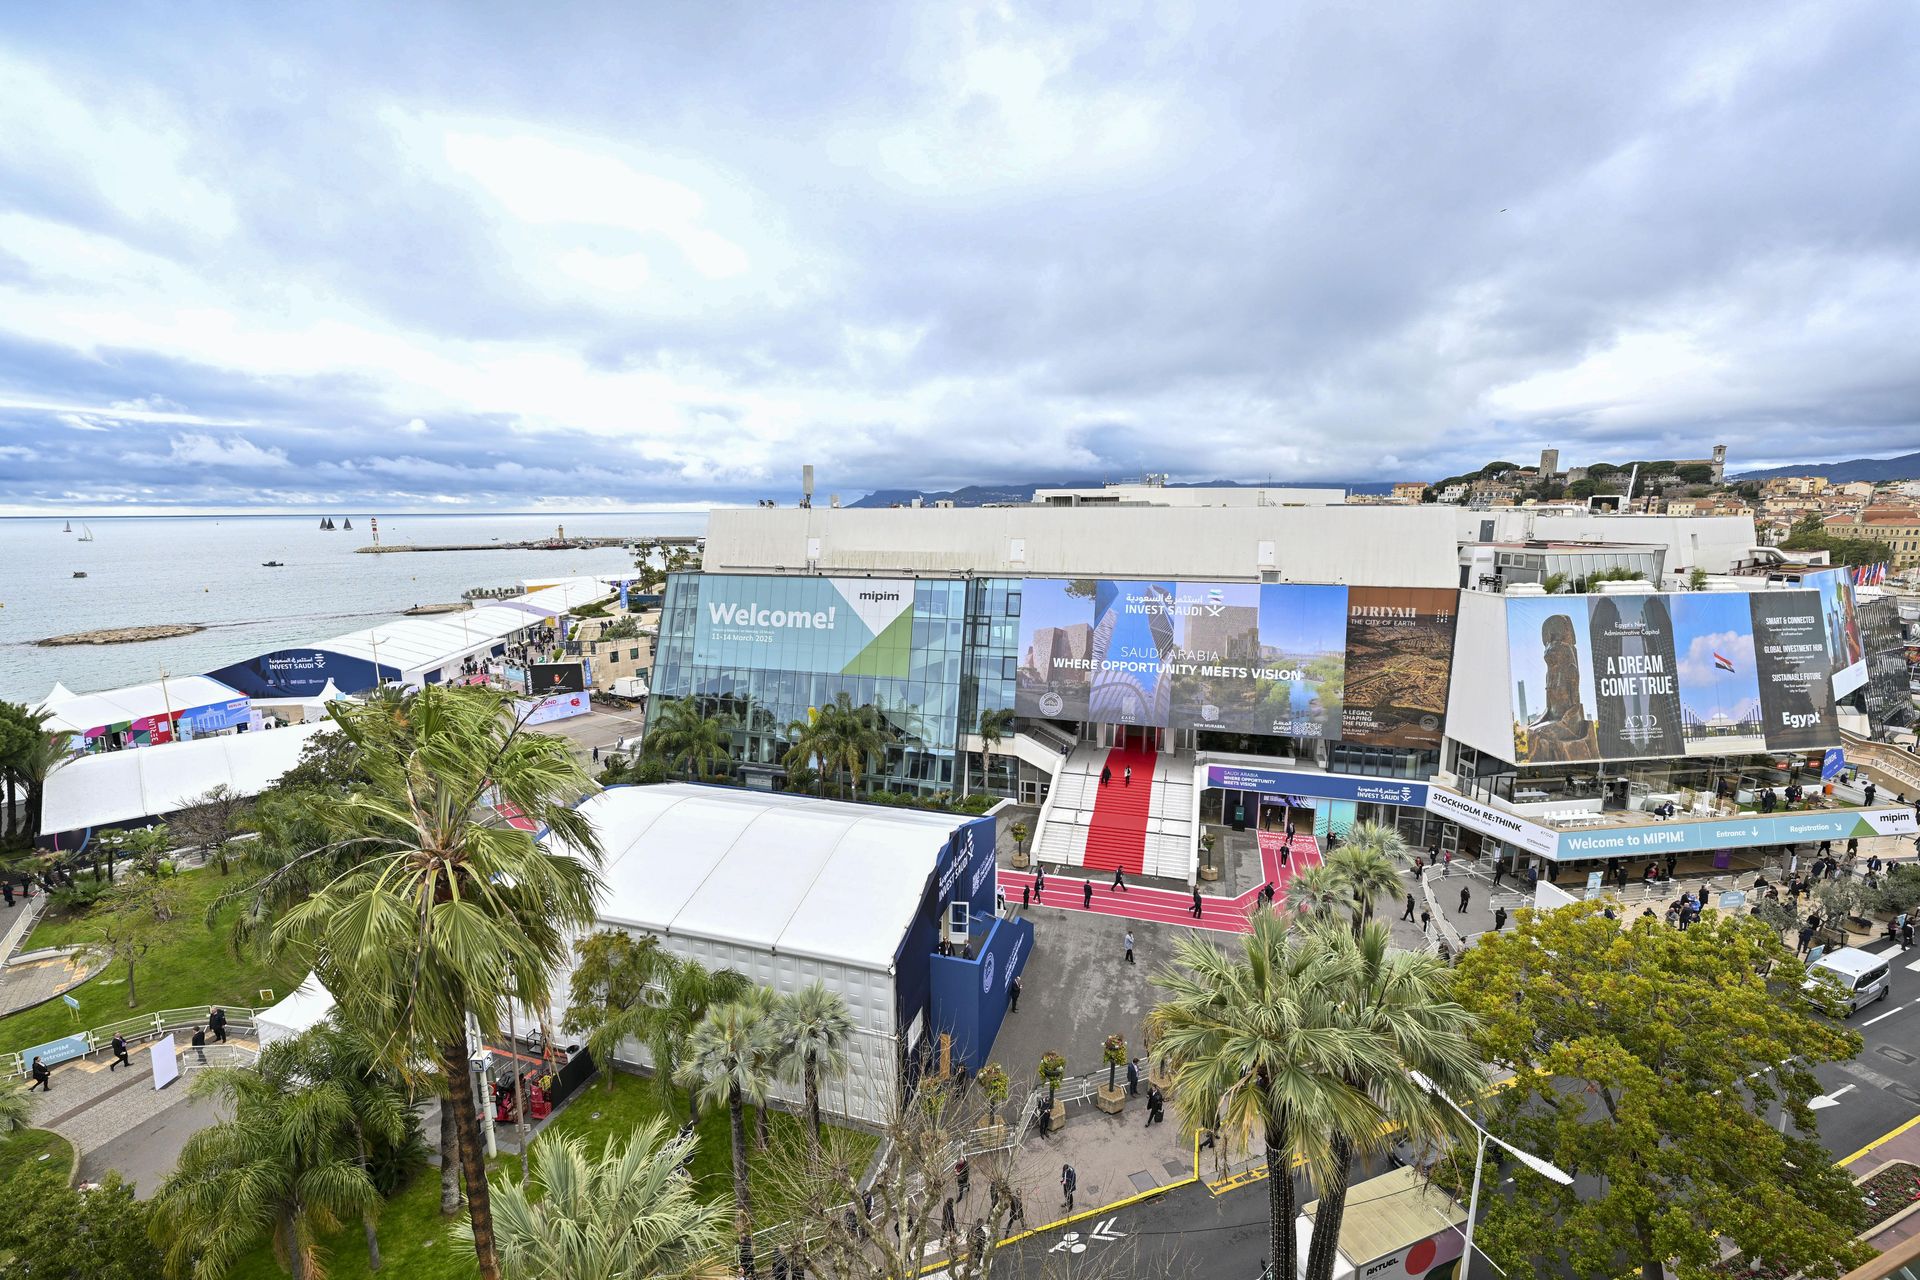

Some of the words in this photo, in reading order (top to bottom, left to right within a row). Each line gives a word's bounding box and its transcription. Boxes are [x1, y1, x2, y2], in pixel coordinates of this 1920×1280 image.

[860, 591, 899, 602] mipim
[709, 602, 836, 629] Welcome!
[1125, 605, 1165, 615] INVEST
[1168, 606, 1202, 616] SAUDI
[1352, 606, 1416, 618] DIRIYAH
[1766, 617, 1782, 625] SMART
[1787, 616, 1815, 624] CONNECTED
[733, 634, 753, 642] March
[1121, 647, 1162, 659] SAUDI
[1168, 650, 1220, 661] ARABIA
[1764, 645, 1782, 653] GLOBAL
[1783, 644, 1812, 652] INVESTMENT
[1813, 644, 1823, 652] HUB
[1053, 658, 1097, 670] WHERE
[1101, 660, 1197, 675] OPPORTUNITY
[1201, 666, 1247, 679] MEETS
[1251, 668, 1301, 680] VISION
[1607, 656, 1616, 674] A
[1618, 655, 1663, 674] DREAM
[1772, 673, 1803, 681] SUSTAINABLE
[1804, 672, 1822, 680] FUTURE
[1601, 677, 1638, 696] COME
[1640, 676, 1673, 695] TRUE
[1782, 711, 1821, 728] Egypt
[1433, 793, 1480, 816] STOCKHOLM
[1482, 811, 1522, 832] RE:THINK
[1880, 812, 1910, 823] mipim
[1716, 829, 1746, 838] Entrance
[1790, 823, 1830, 834] Registration
[1568, 837, 1624, 850] Welcome
[1627, 834, 1640, 846] to
[1643, 831, 1685, 845] MIPIM!
[939, 873, 954, 902] INVEST
[955, 855, 968, 879] SAUDI
[43, 1044, 69, 1055] MIPIM
[1366, 1258, 1399, 1276] AKTUEL
